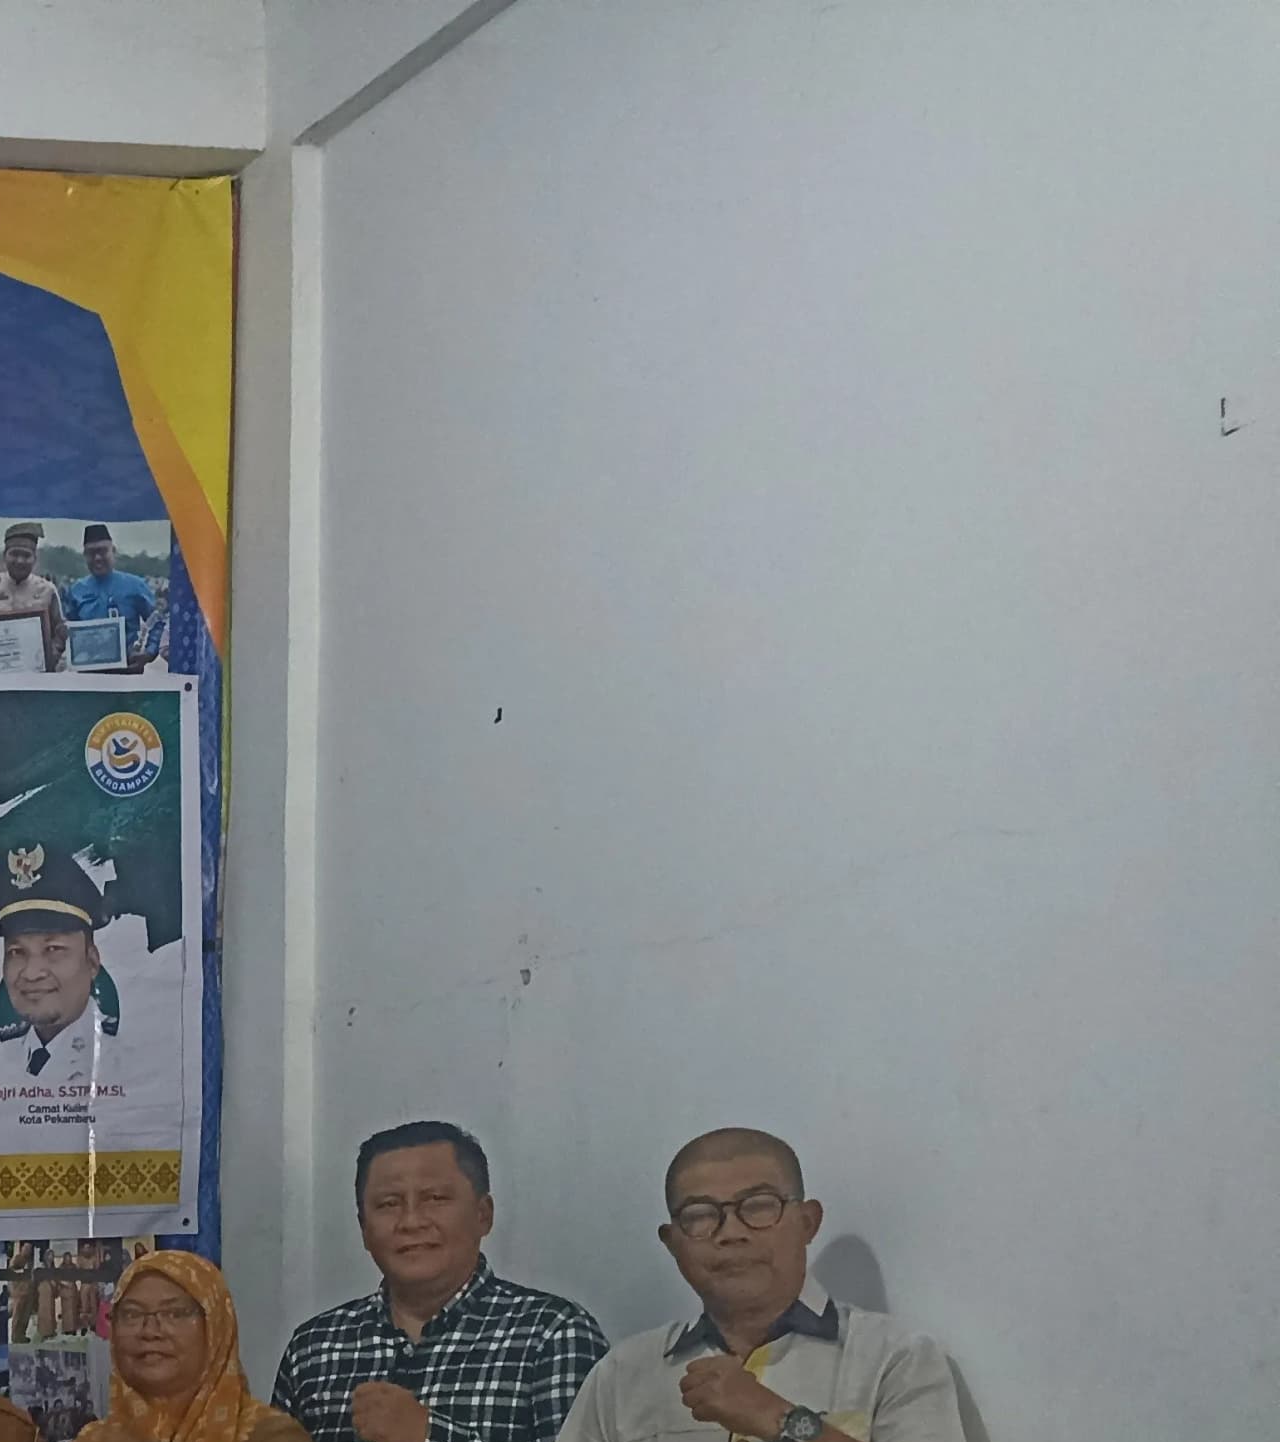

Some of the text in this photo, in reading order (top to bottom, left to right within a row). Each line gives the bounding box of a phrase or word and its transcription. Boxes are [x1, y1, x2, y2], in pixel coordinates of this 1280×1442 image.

[94, 767, 154, 792] BERDAMPAK
[27, 1104, 61, 1114] Camat
[19, 1115, 42, 1125] Kota
